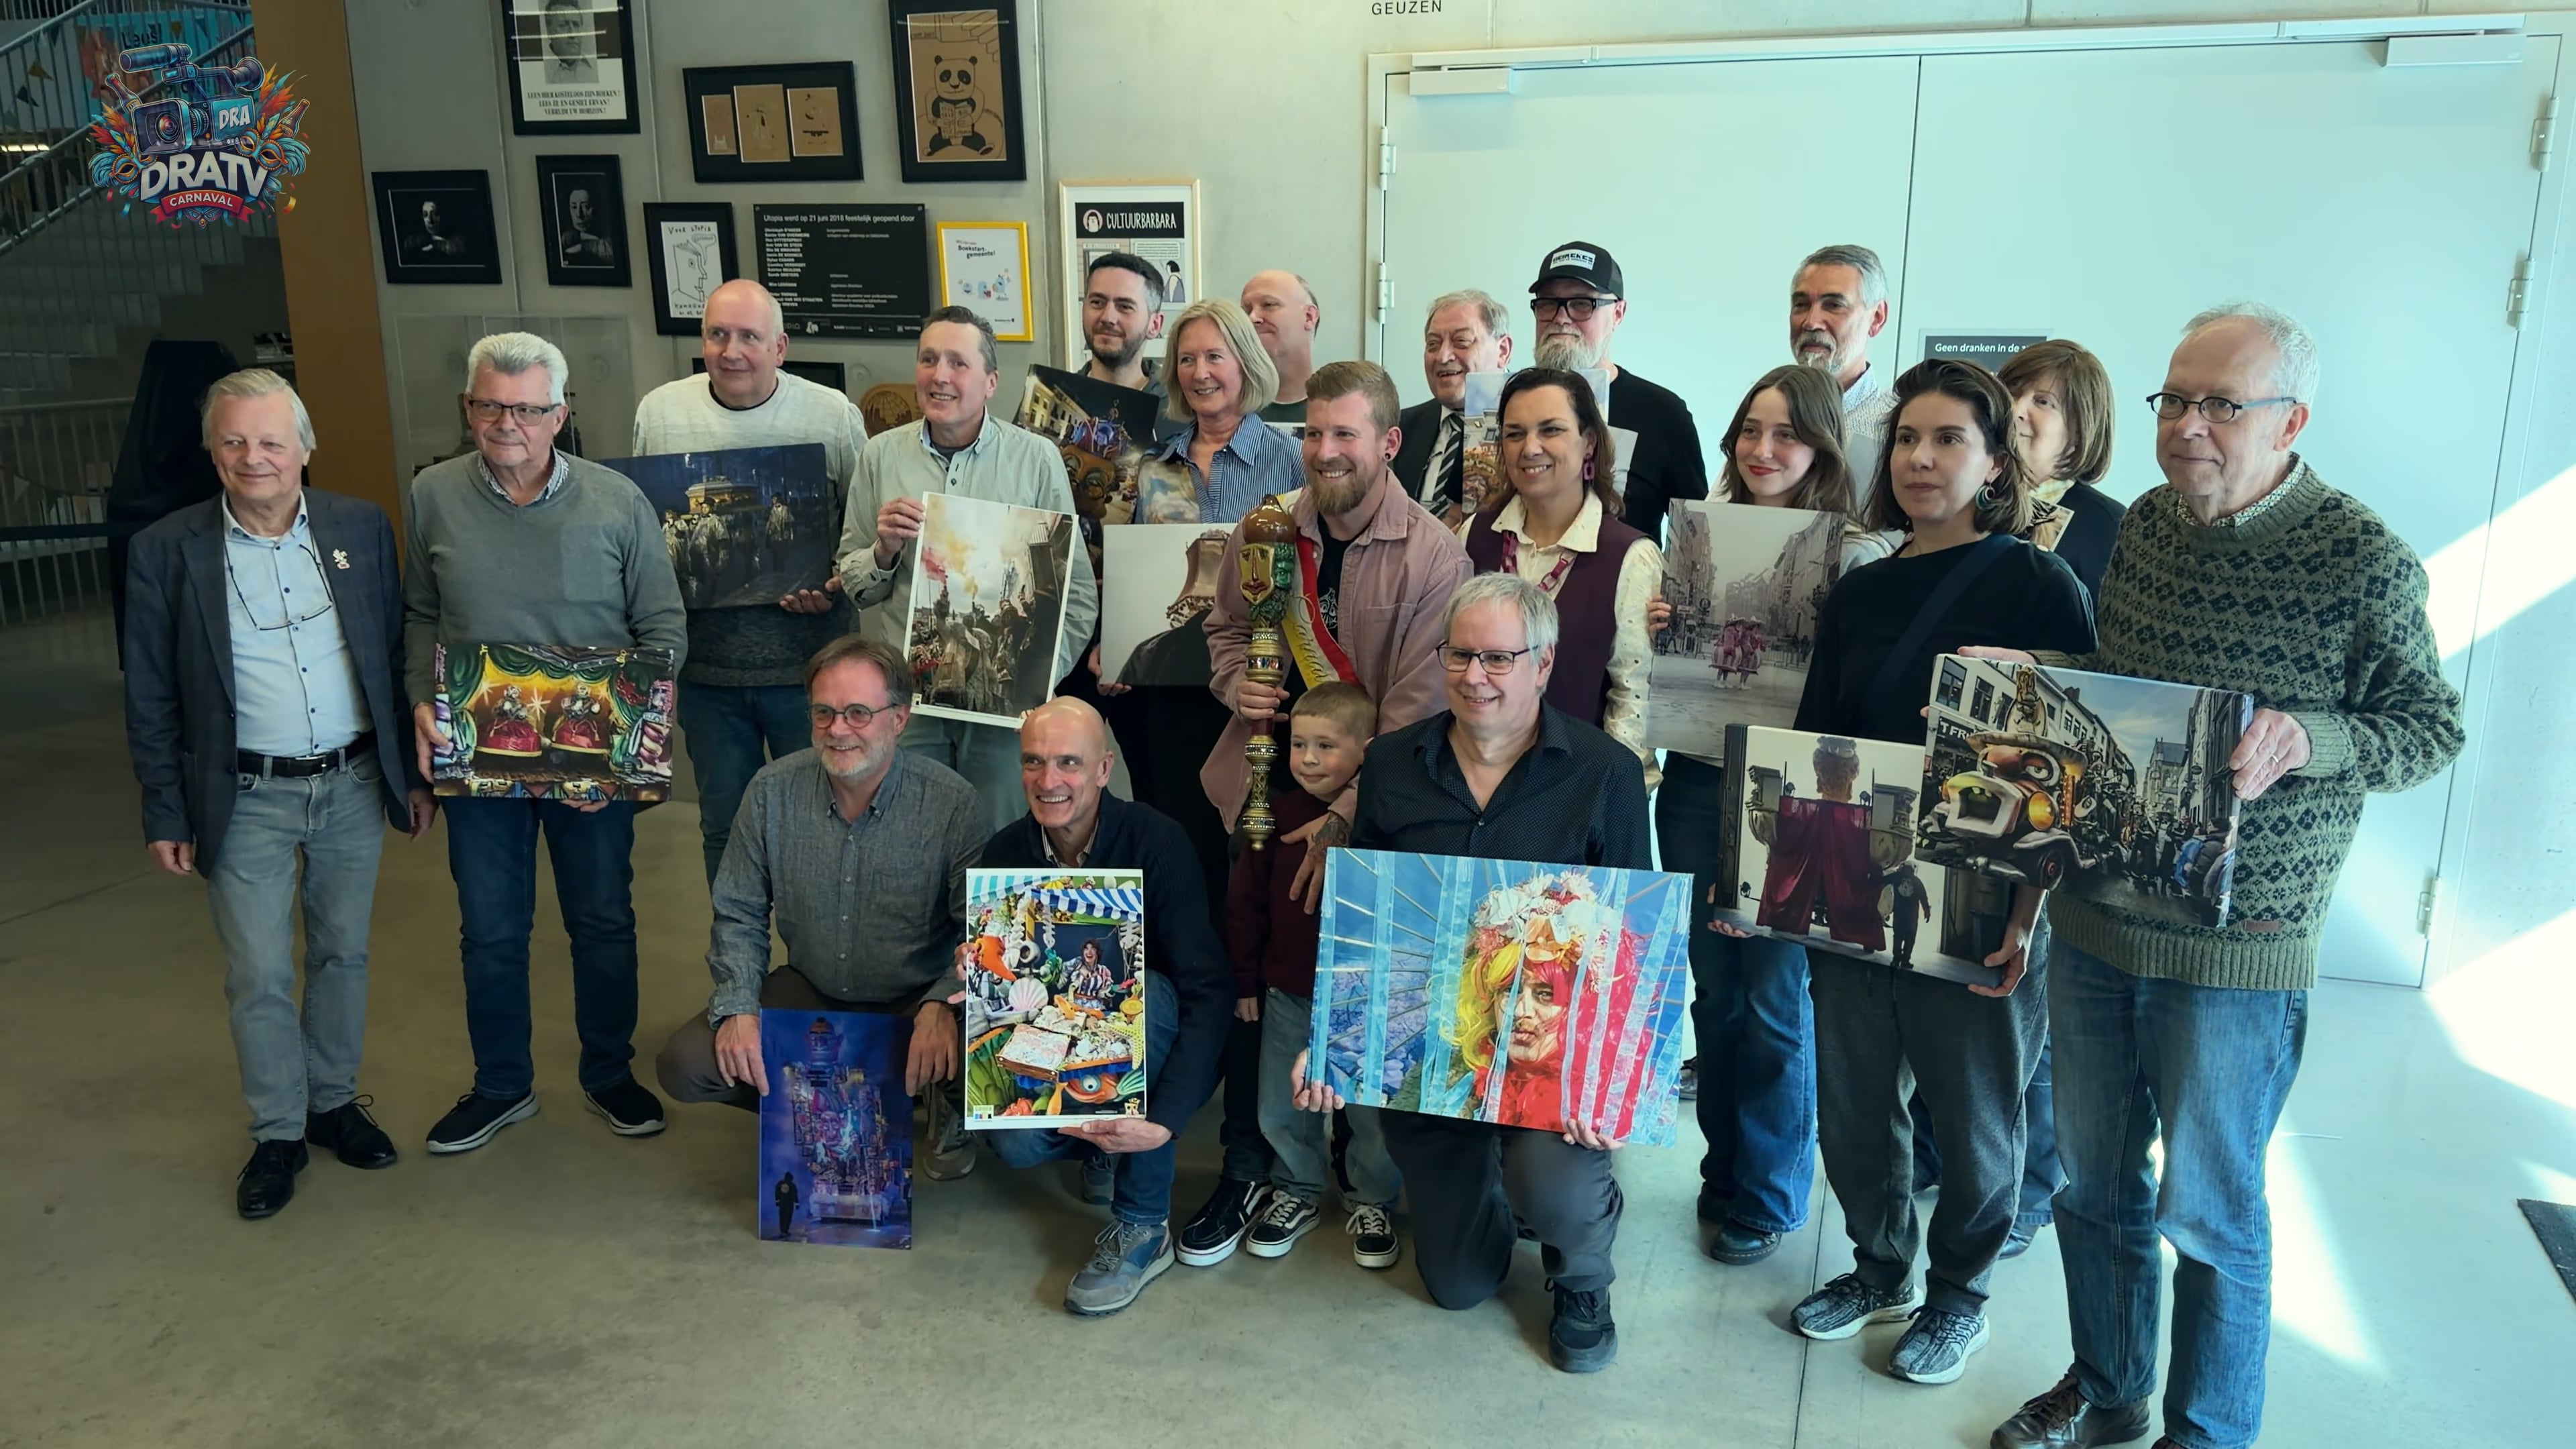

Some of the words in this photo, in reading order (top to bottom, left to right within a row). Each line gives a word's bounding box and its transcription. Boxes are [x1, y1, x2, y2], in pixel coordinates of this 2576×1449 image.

[1372, 0, 1442, 15] GEUZEN
[763, 215, 784, 223] Utopia
[817, 215, 828, 223] juni
[845, 215, 871, 223] feestelijk
[873, 215, 900, 223] geopend
[1106, 212, 1177, 229] CULTUURBARBARA
[1935, 343, 1958, 352] Geen
[1960, 343, 1995, 352] dranken
[1998, 343, 2006, 353] in
[2008, 343, 2019, 353] de
